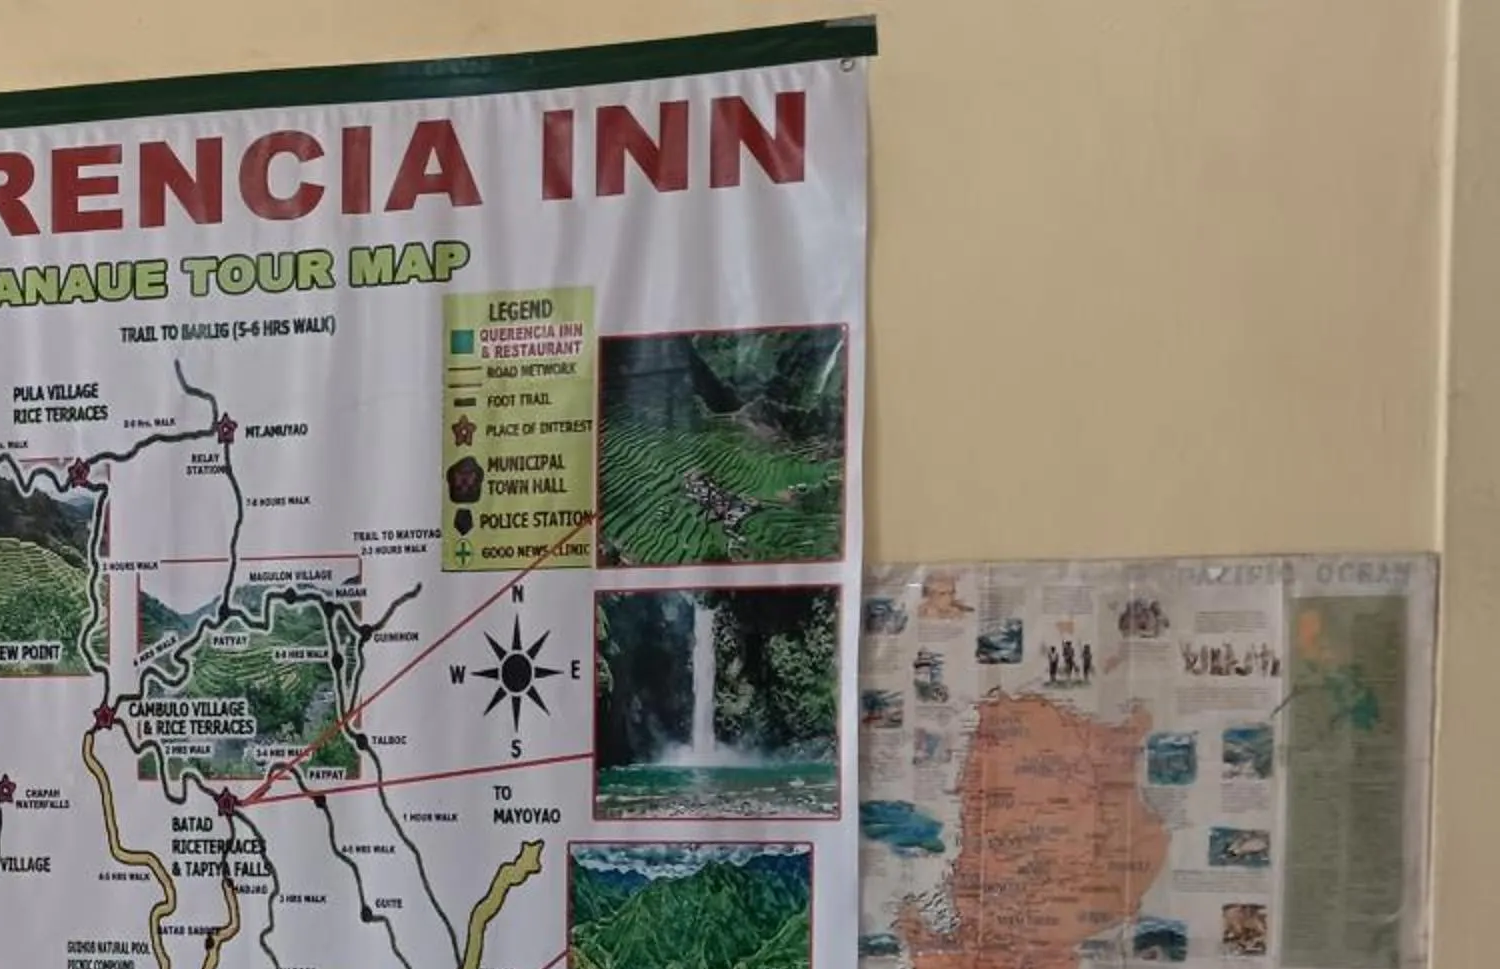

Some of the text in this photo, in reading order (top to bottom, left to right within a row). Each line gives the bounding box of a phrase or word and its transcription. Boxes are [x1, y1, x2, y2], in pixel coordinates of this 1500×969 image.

[542, 91, 806, 200] INN
[182, 249, 336, 297] TOUR
[349, 240, 471, 288] MAP
[489, 299, 553, 322] LEGEND
[120, 326, 158, 343] TRAIL
[161, 325, 178, 341] TO
[181, 322, 230, 340] BARLIG
[263, 319, 289, 336] HRS
[292, 315, 338, 336] WALK)
[479, 322, 583, 342] QUERENCIA INN
[481, 340, 583, 359] & RESTAURANT
[487, 362, 576, 378] ROAD NETWORK
[13, 383, 99, 402] PULA VILLAGE
[487, 393, 552, 408] FOOT TRAIL
[13, 405, 109, 425] RICE TERRACES
[486, 419, 593, 437] PLACE OF INTEREST
[191, 453, 220, 464] RELAY
[487, 454, 565, 473] MUNICIPAL
[185, 465, 226, 476] STATION
[487, 477, 567, 496] TOWN HALL
[288, 495, 310, 505] WALK
[479, 509, 593, 529] POLICE STATION
[353, 528, 442, 541] TRAIL TO MAYOYAO
[375, 544, 427, 555] HOURS WALK
[481, 543, 590, 559] GOOD NEWS CLINIC
[136, 561, 159, 571] WALK
[295, 570, 333, 581] VILLAGE
[512, 585, 524, 603] N
[22, 644, 61, 660] POINT
[449, 660, 581, 684] W E
[129, 701, 245, 719] CAMBULO VILLAGE
[143, 719, 254, 736] & RICE TERRACES
[189, 744, 211, 754] WALK
[511, 739, 522, 758] S
[494, 785, 512, 801] TO
[16, 799, 70, 810] WATERFALLS
[432, 812, 458, 822] WALK
[493, 807, 561, 824] MAYOYAO
[171, 817, 213, 832] BATAD
[373, 845, 395, 854] WALK
[0, 856, 51, 872] VILLAGE
[171, 860, 272, 877] & TAPIYA FALLS
[129, 872, 151, 881] WALK
[304, 895, 327, 904] WALK
[97, 941, 151, 954] NATURAL POOL
